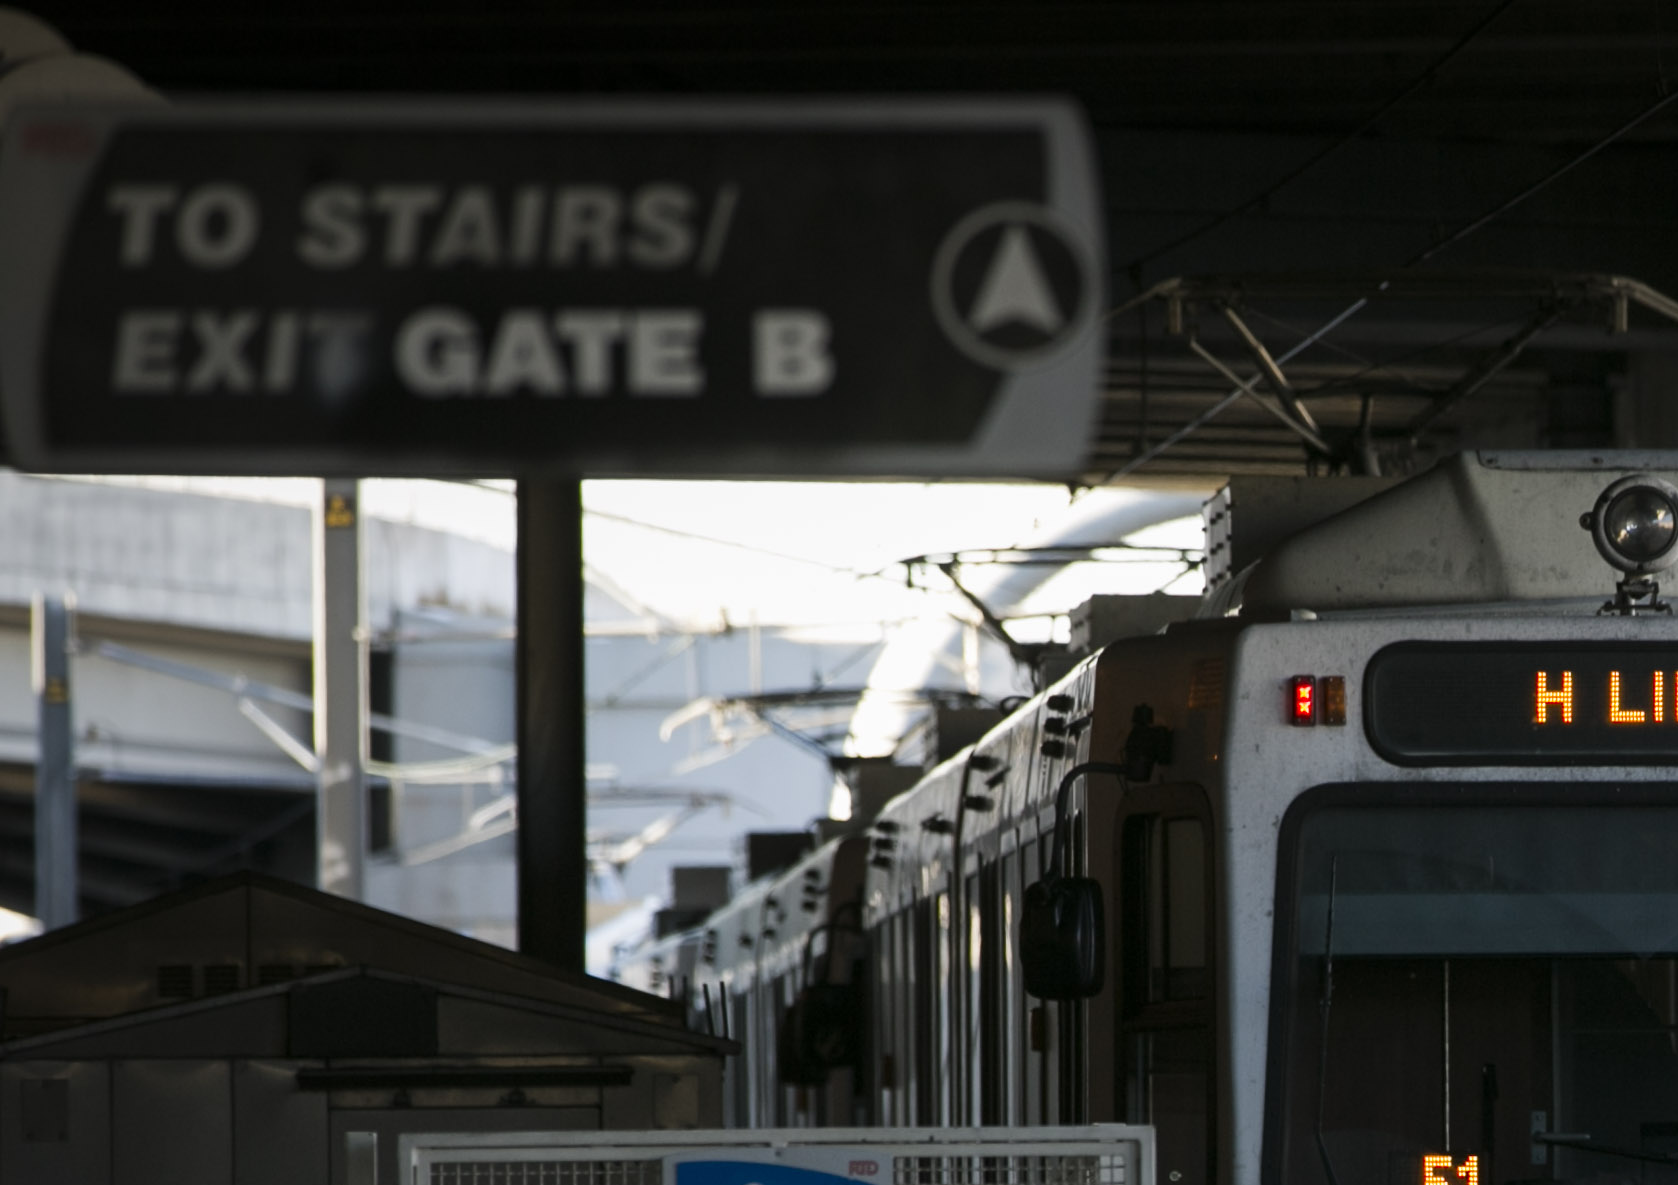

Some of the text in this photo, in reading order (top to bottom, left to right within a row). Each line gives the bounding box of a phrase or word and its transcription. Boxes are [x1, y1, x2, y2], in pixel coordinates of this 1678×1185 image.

[106, 180, 740, 272] TO STAIRS/
[112, 310, 835, 398] EXIT GATE B
[1535, 671, 1573, 724] H
[849, 1160, 879, 1176] RTD
